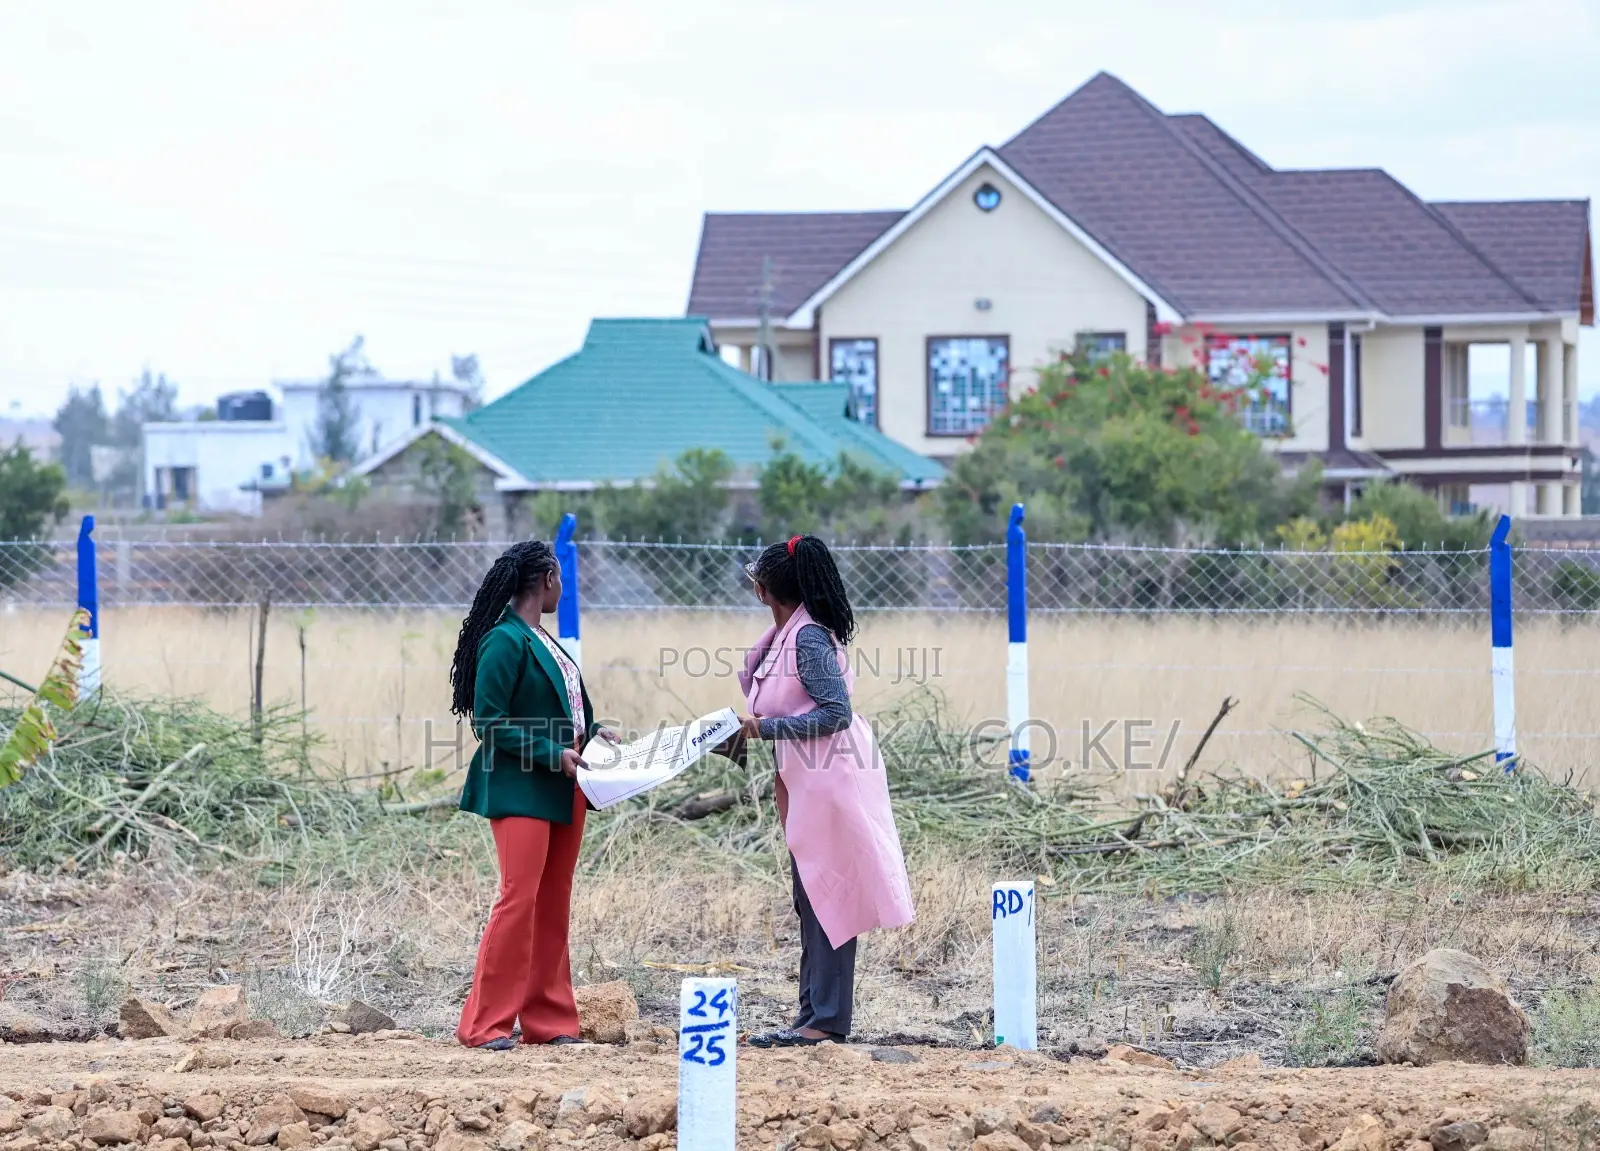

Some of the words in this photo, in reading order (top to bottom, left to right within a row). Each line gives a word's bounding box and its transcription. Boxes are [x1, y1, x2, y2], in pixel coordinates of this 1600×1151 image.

[691, 721, 723, 747] Fanaka
[687, 988, 729, 1018] 24
[683, 1034, 726, 1067] 25
